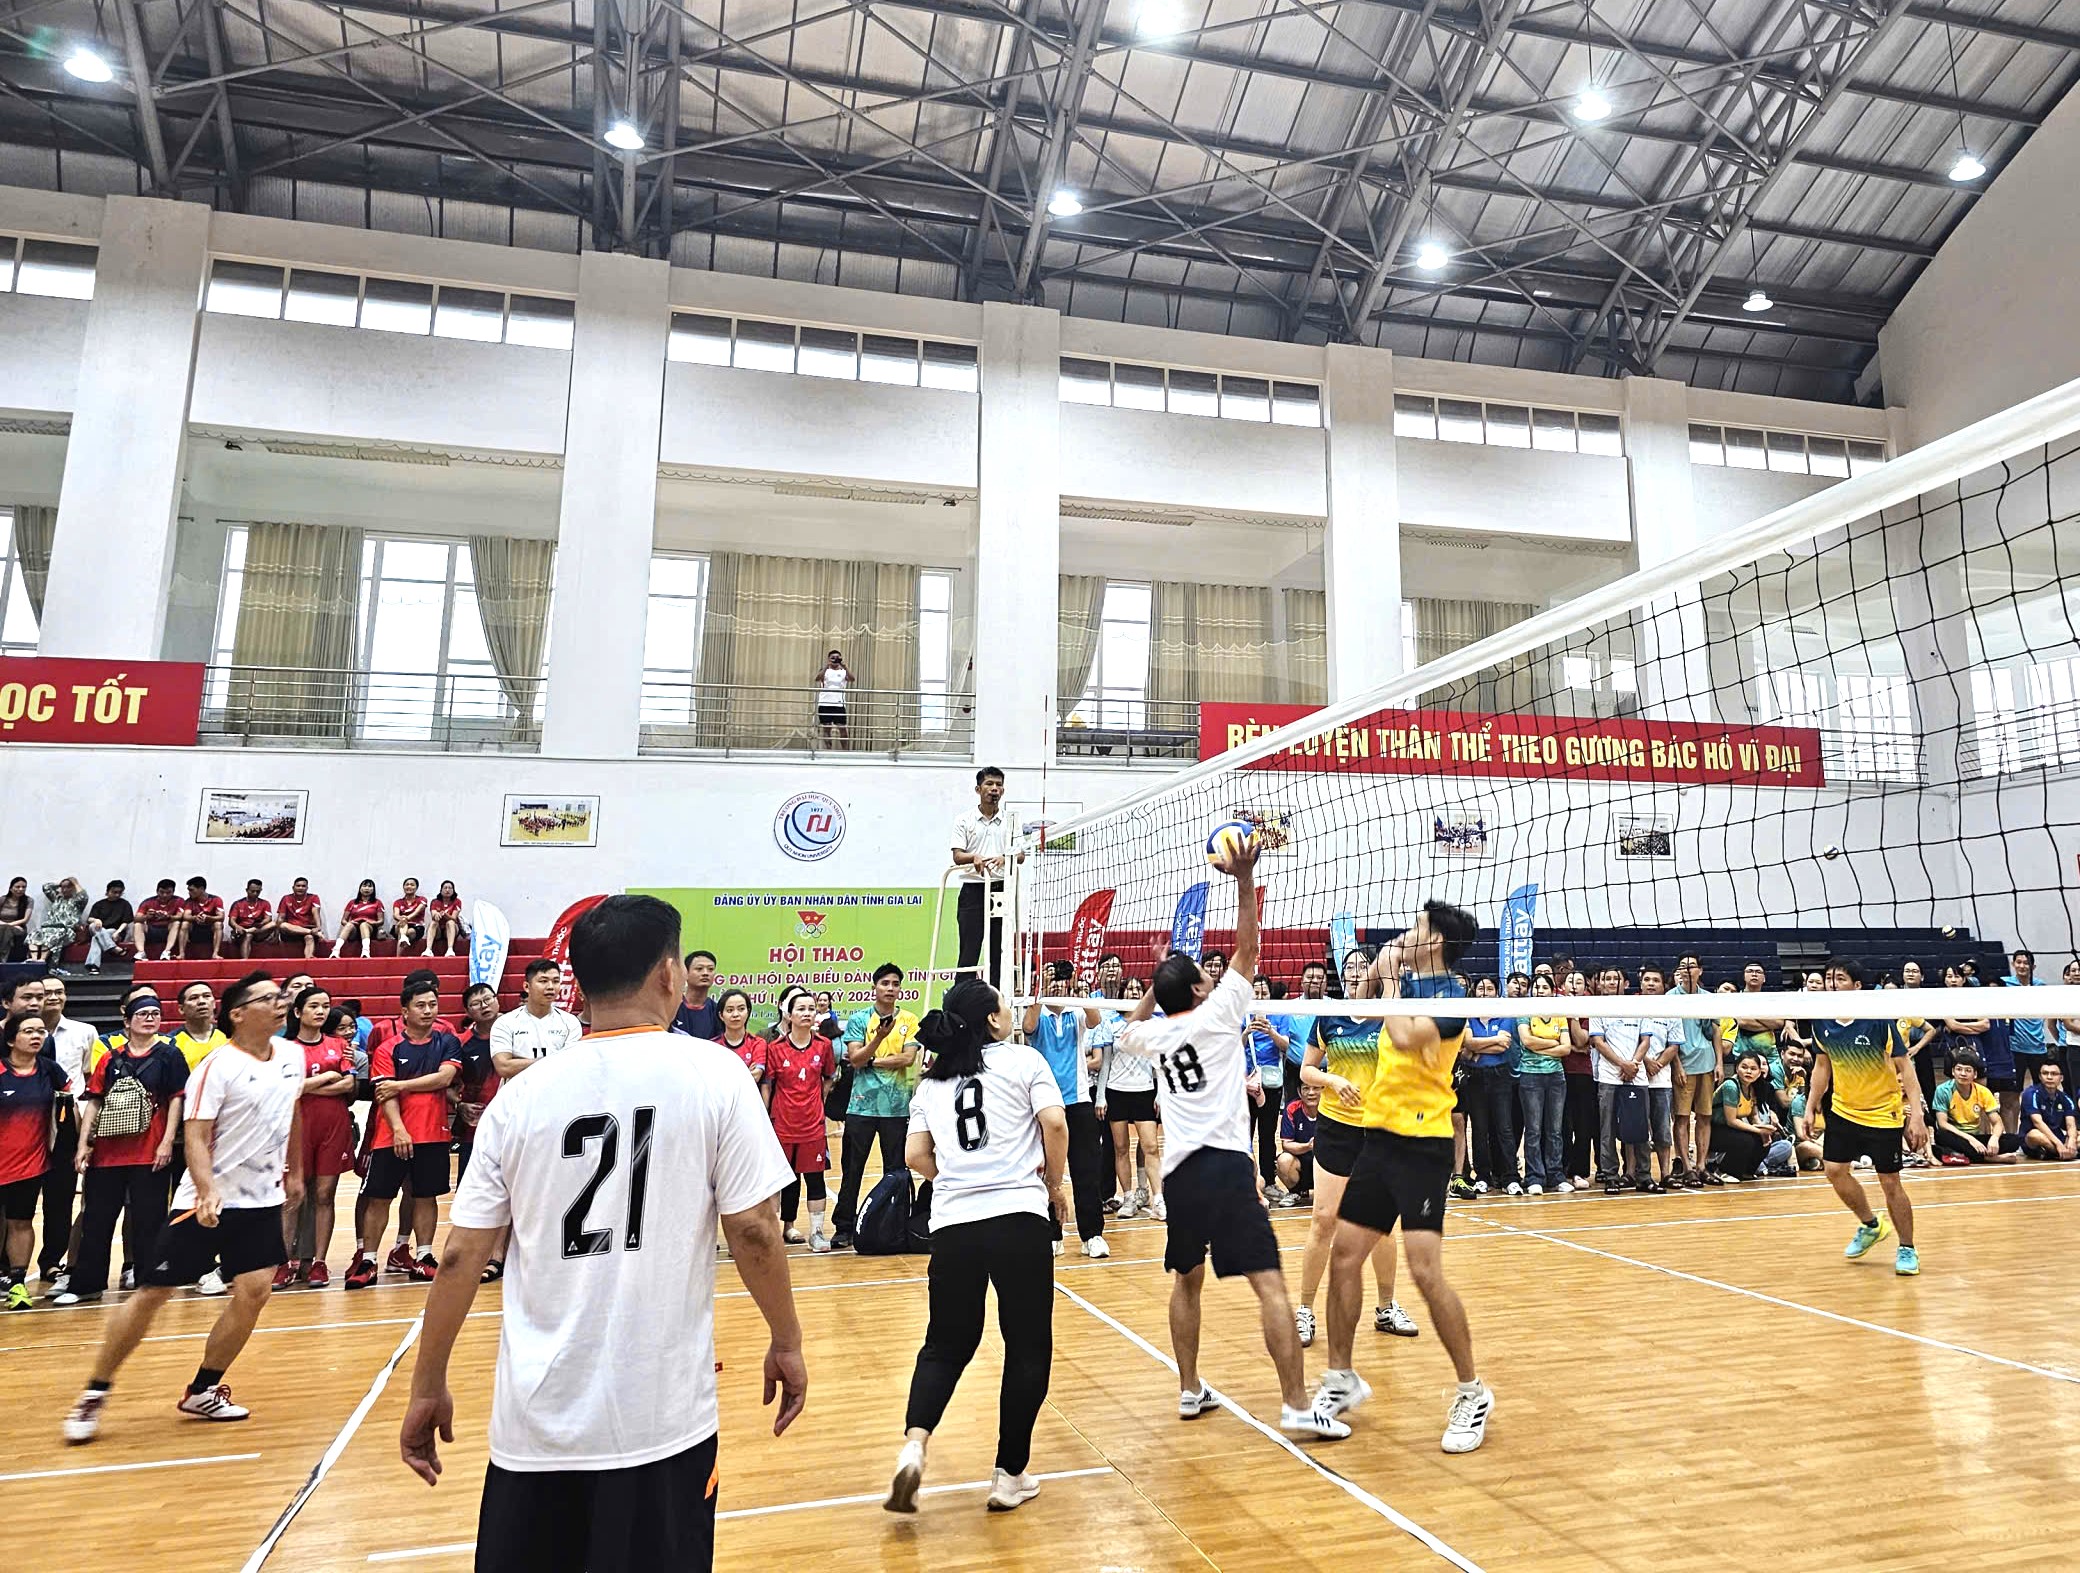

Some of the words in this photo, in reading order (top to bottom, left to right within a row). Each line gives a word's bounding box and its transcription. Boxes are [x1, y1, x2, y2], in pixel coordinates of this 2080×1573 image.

[72, 673, 148, 724] TỐT
[1376, 725, 1440, 760] THÂN
[1450, 722, 1492, 762] THỂ
[1499, 734, 1557, 765] THEO
[1565, 735, 1644, 768] GƯƠNG
[1649, 735, 1697, 770] BÁC
[1703, 734, 1733, 771] HỒ
[1765, 745, 1801, 779] ĐẠI
[714, 893, 744, 906] ĐẢNG
[747, 893, 760, 906] ỦY
[763, 893, 777, 906] ỦY
[780, 896, 801, 906] BAN
[805, 894, 834, 906] NHÂN
[837, 894, 858, 905] DÂN
[861, 893, 884, 905] TỈNH
[887, 895, 904, 905] GIA
[907, 895, 922, 905] LAI
[769, 943, 805, 967] HỘI
[812, 947, 864, 962] THAO
[1081, 918, 1105, 984] attay
[1514, 908, 1533, 976] attay
[730, 974, 753, 988] ĐẠI
[757, 971, 781, 988] HỘI
[813, 966, 840, 984] BIỂU
[844, 968, 874, 983] ĐẢN
[848, 991, 877, 1002] 2025
[898, 990, 919, 1001] 030
[798, 1067, 806, 1081] 4
[1160, 1043, 1207, 1094] 18
[954, 1078, 990, 1153] 8
[561, 1106, 656, 1259] 21
